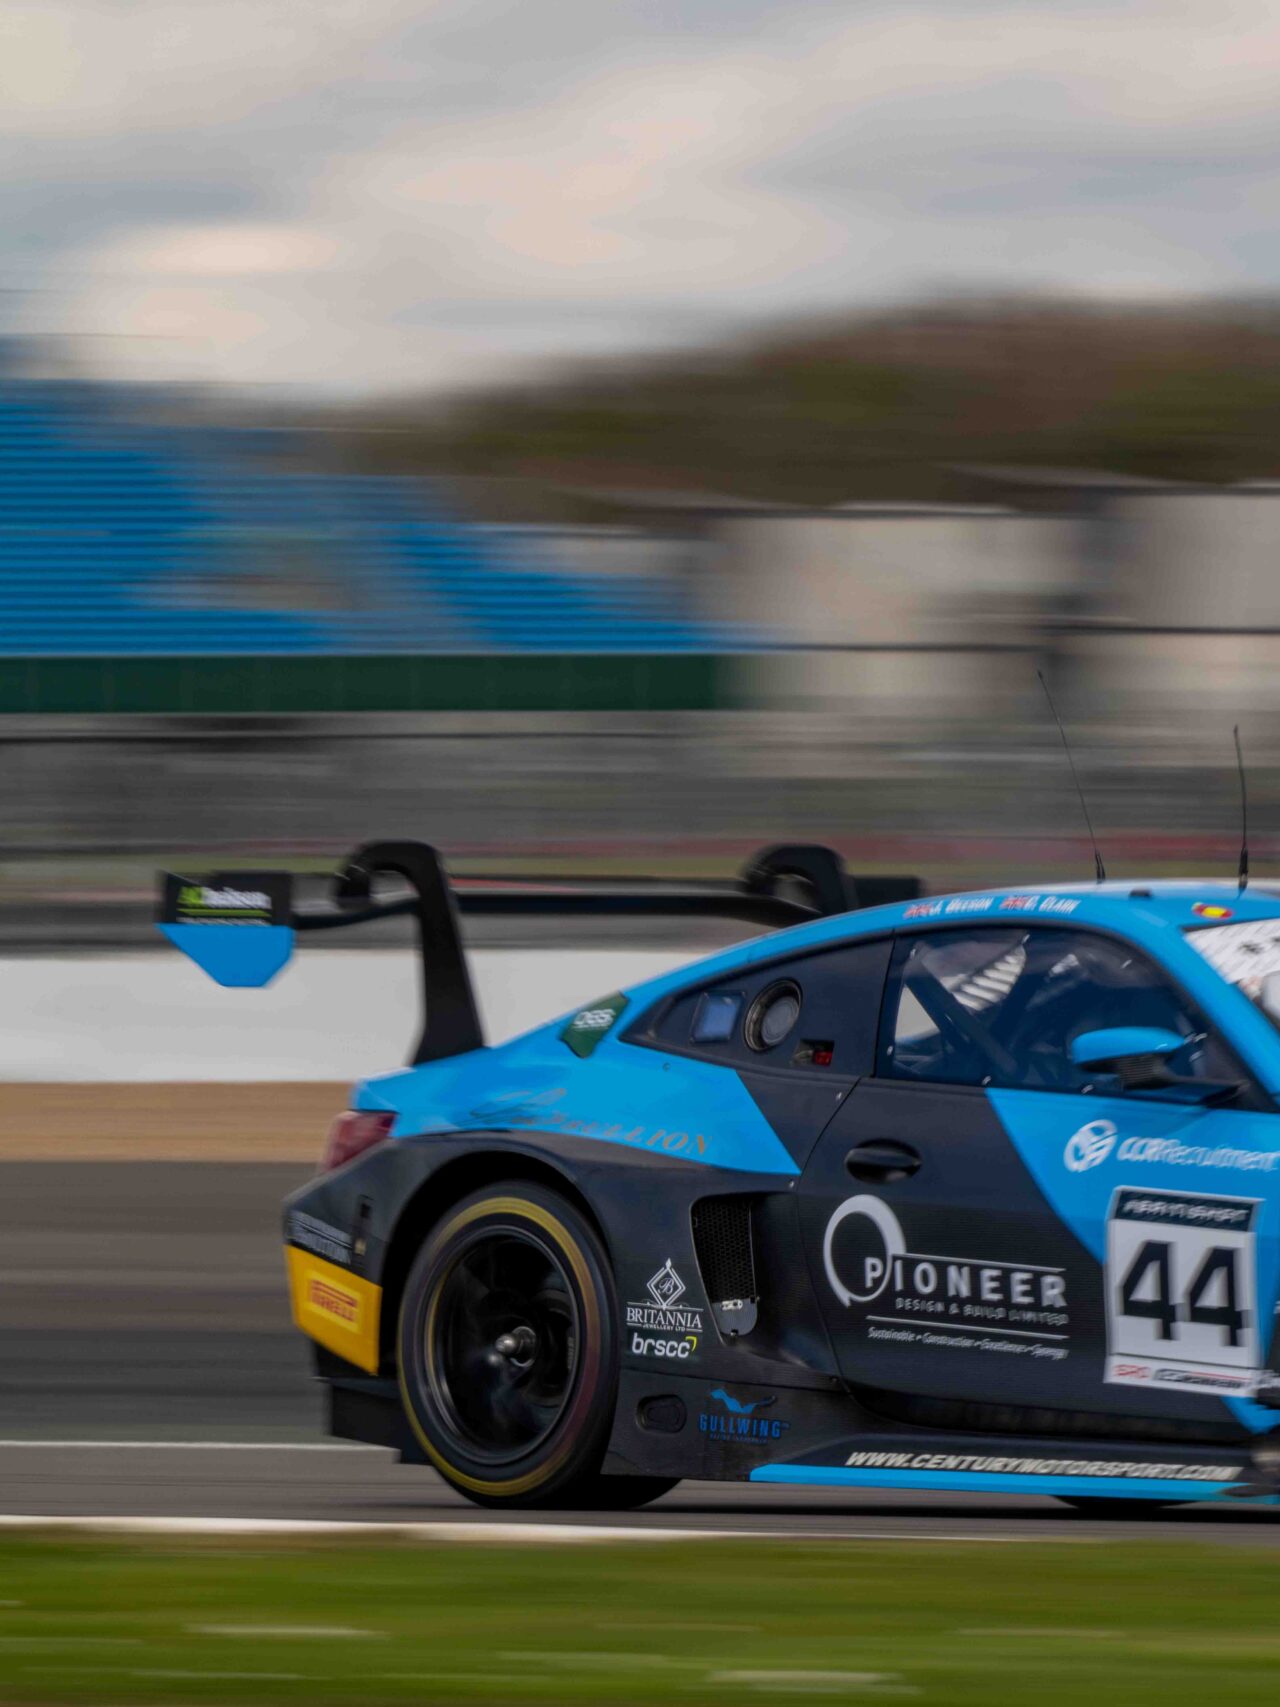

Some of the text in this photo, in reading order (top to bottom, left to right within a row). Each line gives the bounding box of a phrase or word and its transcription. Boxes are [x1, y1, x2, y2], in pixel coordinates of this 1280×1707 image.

[864, 1256, 1067, 1308] PIONEER
[1117, 1238, 1245, 1347] 44
[626, 1306, 702, 1329] BRITANNIA
[895, 1297, 1070, 1326] DESIGN & BUILD LIMITED
[631, 1332, 691, 1358] brscc
[699, 1412, 782, 1439] GULLWING
[844, 1451, 1244, 1481] WWW.CENTURYMOTORSPORT.COM
